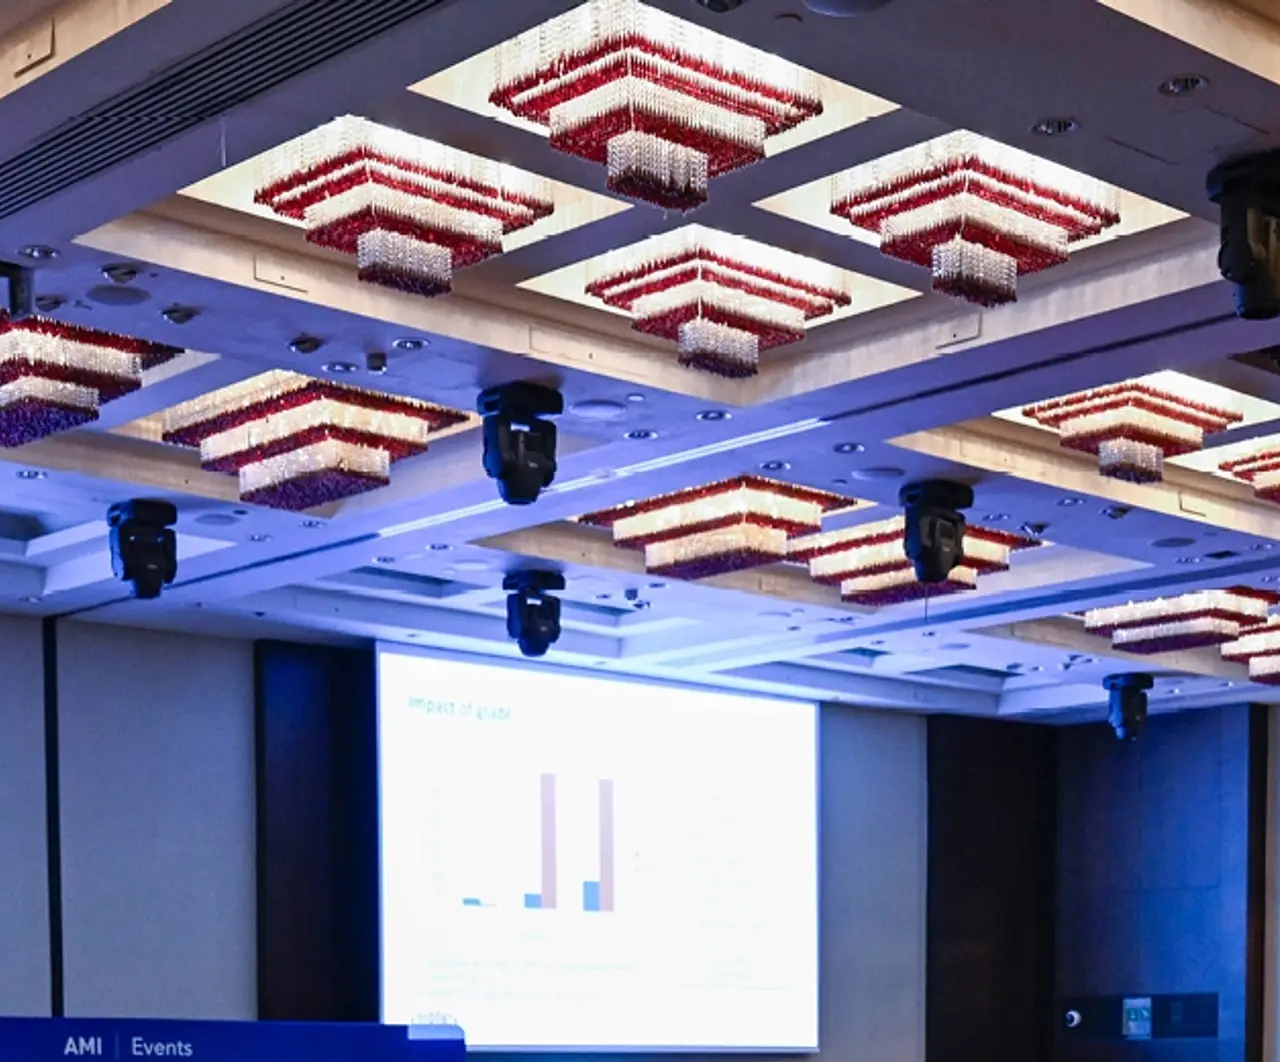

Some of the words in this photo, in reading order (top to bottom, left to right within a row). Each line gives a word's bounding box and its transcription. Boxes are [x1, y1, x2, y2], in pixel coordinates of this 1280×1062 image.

[408, 695, 455, 715] Impact
[460, 699, 473, 716] of
[64, 1036, 102, 1056] AMI
[131, 1037, 194, 1057] Events
